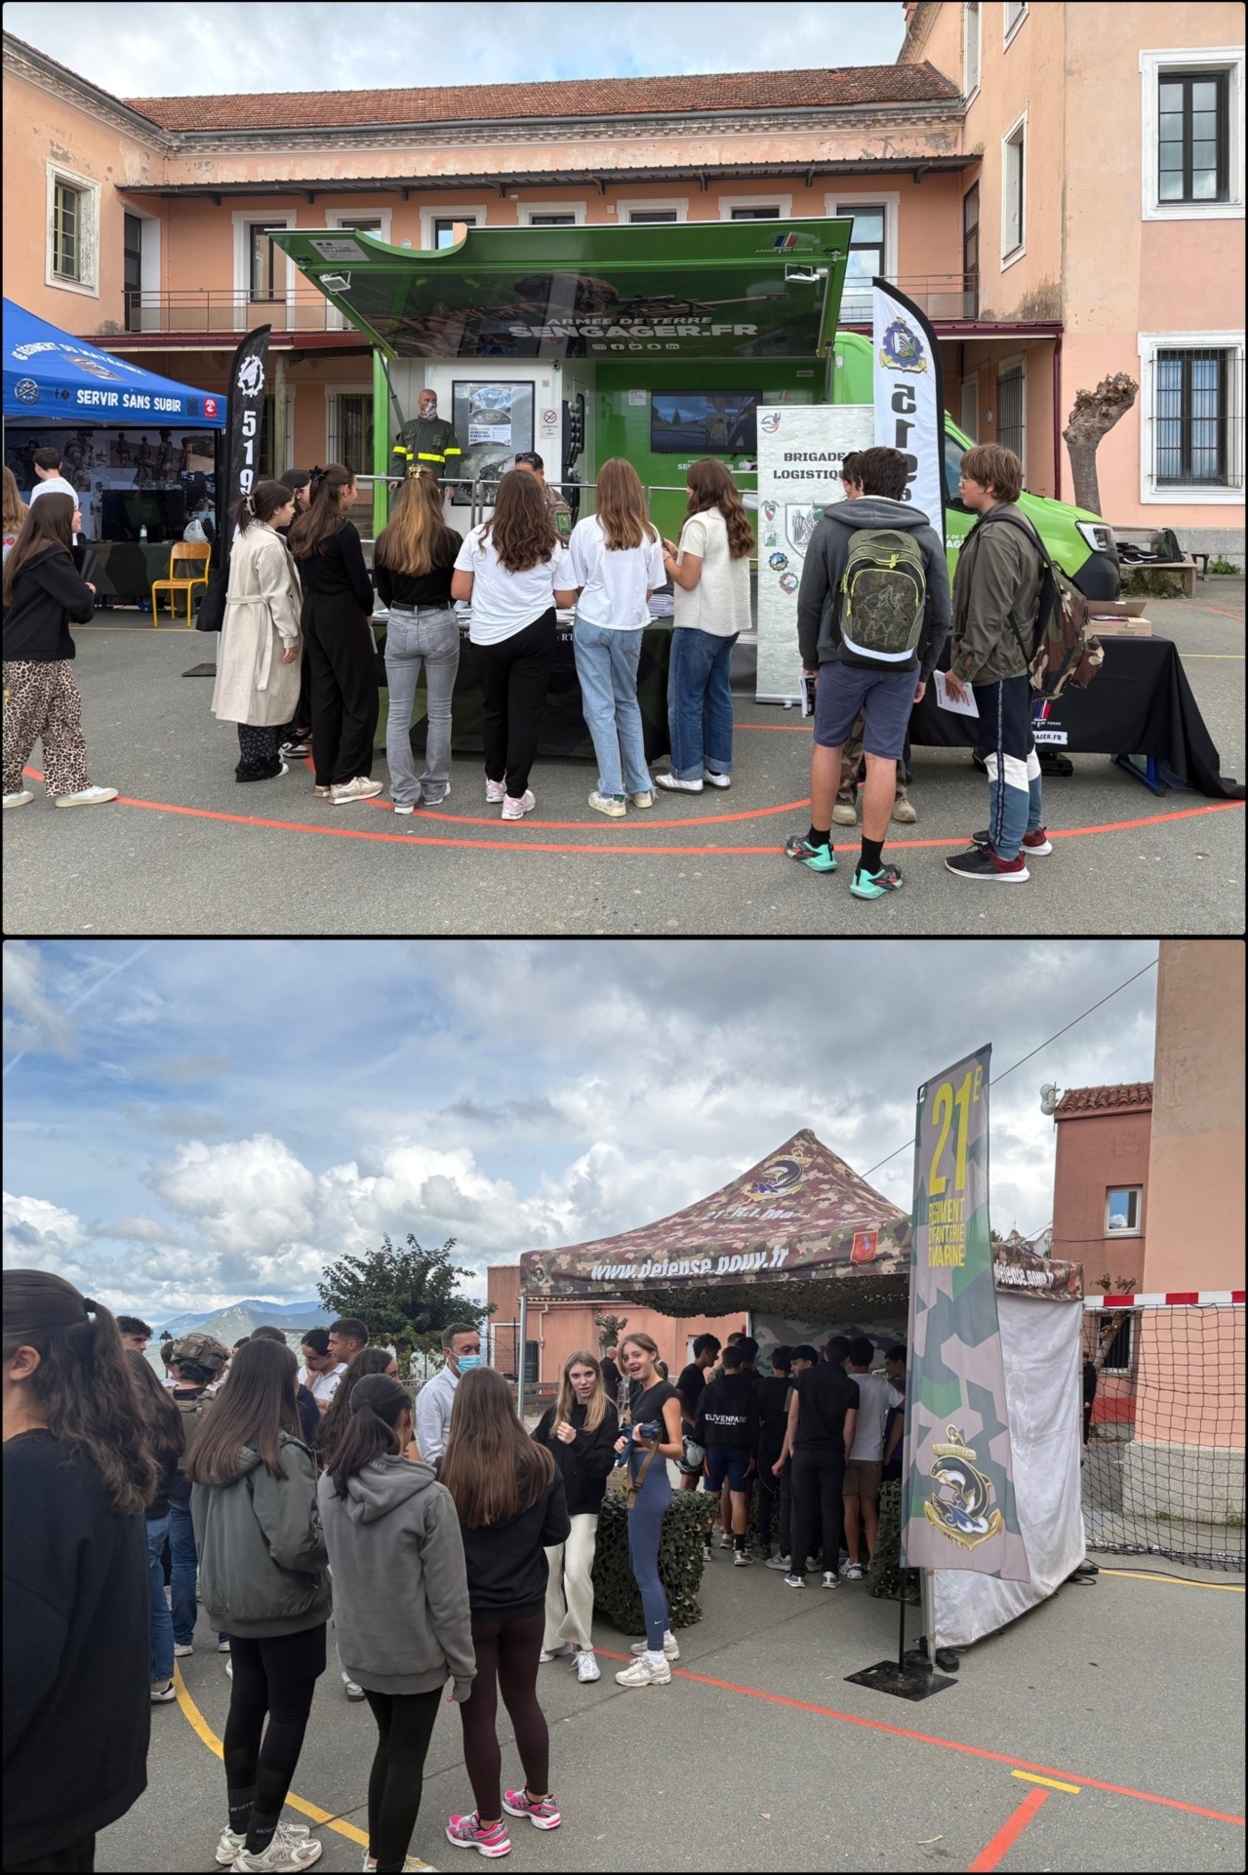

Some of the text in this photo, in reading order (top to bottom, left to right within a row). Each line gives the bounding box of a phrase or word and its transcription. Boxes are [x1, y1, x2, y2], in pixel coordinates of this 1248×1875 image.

[617, 317, 650, 325] DE
[650, 316, 713, 324] TERRE
[508, 324, 758, 338] SENGAGER.FR
[77, 389, 182, 413] SERVIR SANS SUBIR
[783, 452, 846, 462] BRIGADE
[773, 469, 842, 481] LOGISTIQ
[1035, 733, 1062, 741] AGER.FR
[590, 1244, 789, 1281] www.defense.gouv.fr
[993, 1258, 1054, 1290] defense.gouv.fr
